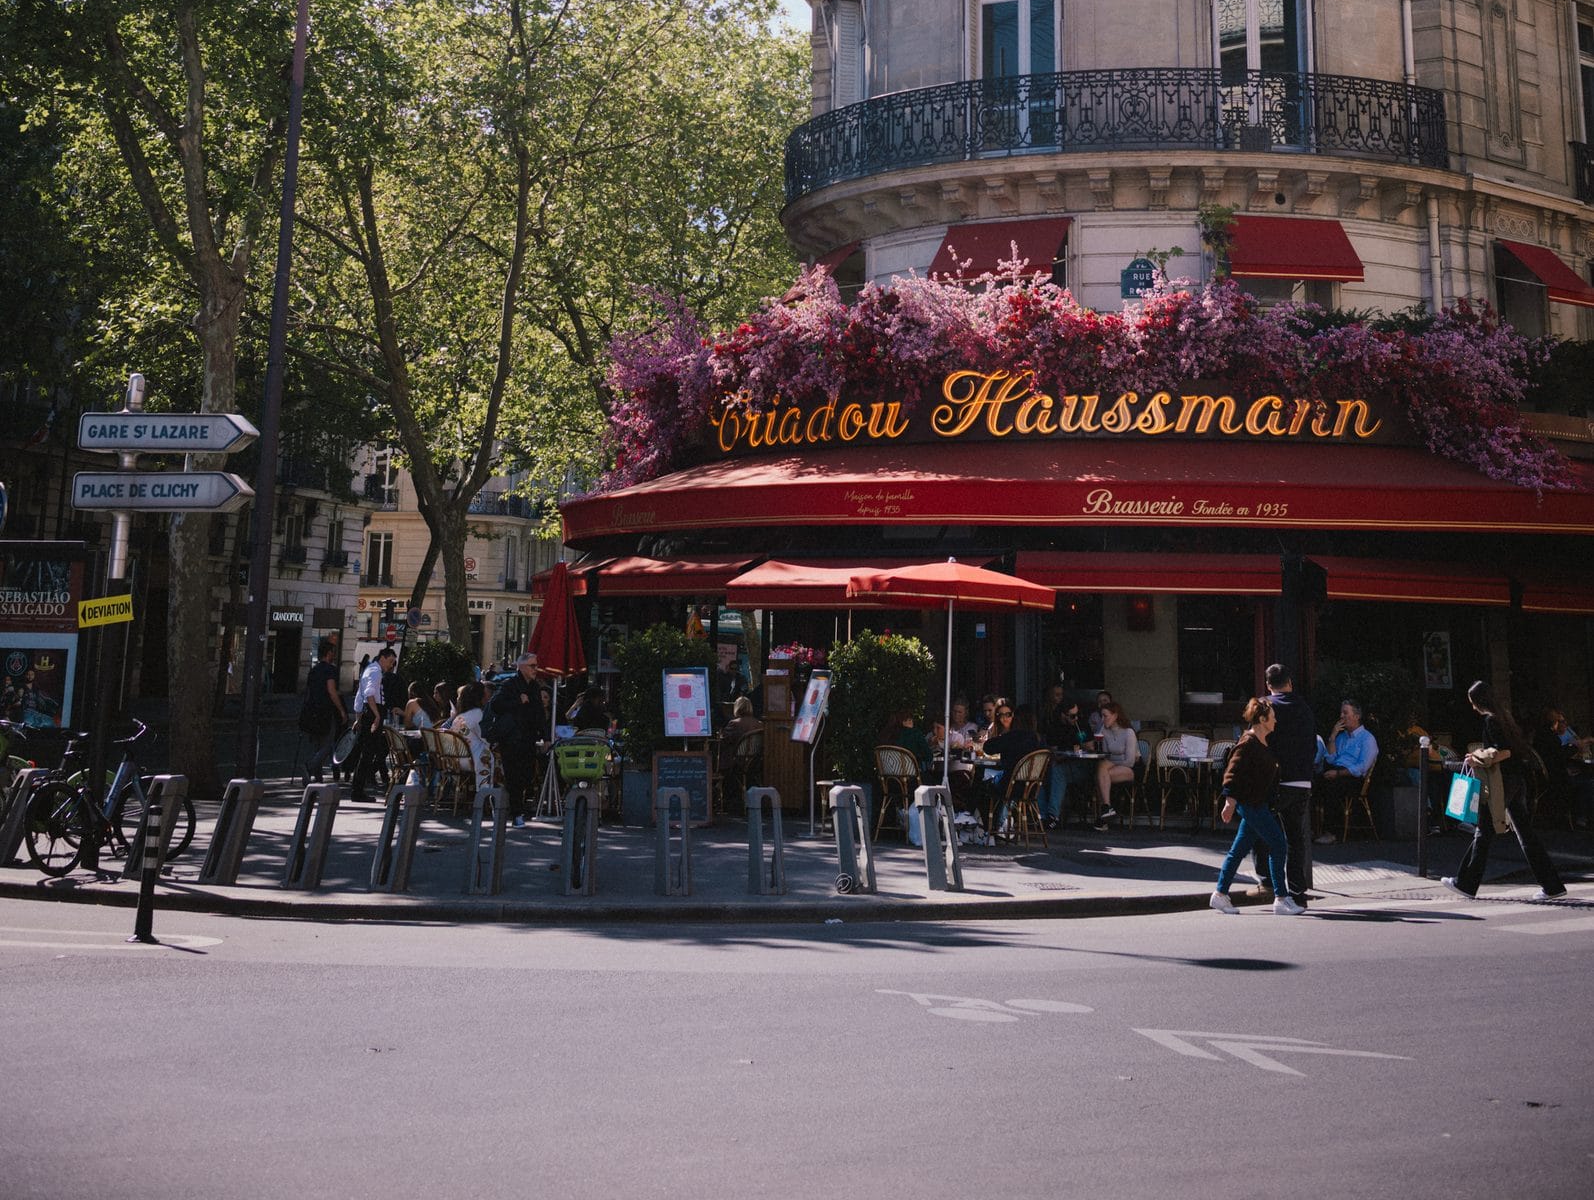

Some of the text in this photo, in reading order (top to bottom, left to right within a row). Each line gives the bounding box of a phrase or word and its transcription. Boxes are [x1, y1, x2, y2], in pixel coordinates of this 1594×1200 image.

[1132, 273, 1151, 281] RUE
[930, 369, 1383, 439] Haussmann
[87, 424, 129, 439] GARE
[151, 425, 209, 440] LAZARE
[81, 483, 200, 499] PLACE DE CLICHY
[1082, 488, 1289, 517] Brasserie Fondée en 1935
[465, 573, 478, 581] BC
[1, 603, 65, 616] SALGADO
[87, 601, 131, 620] DEVIATION
